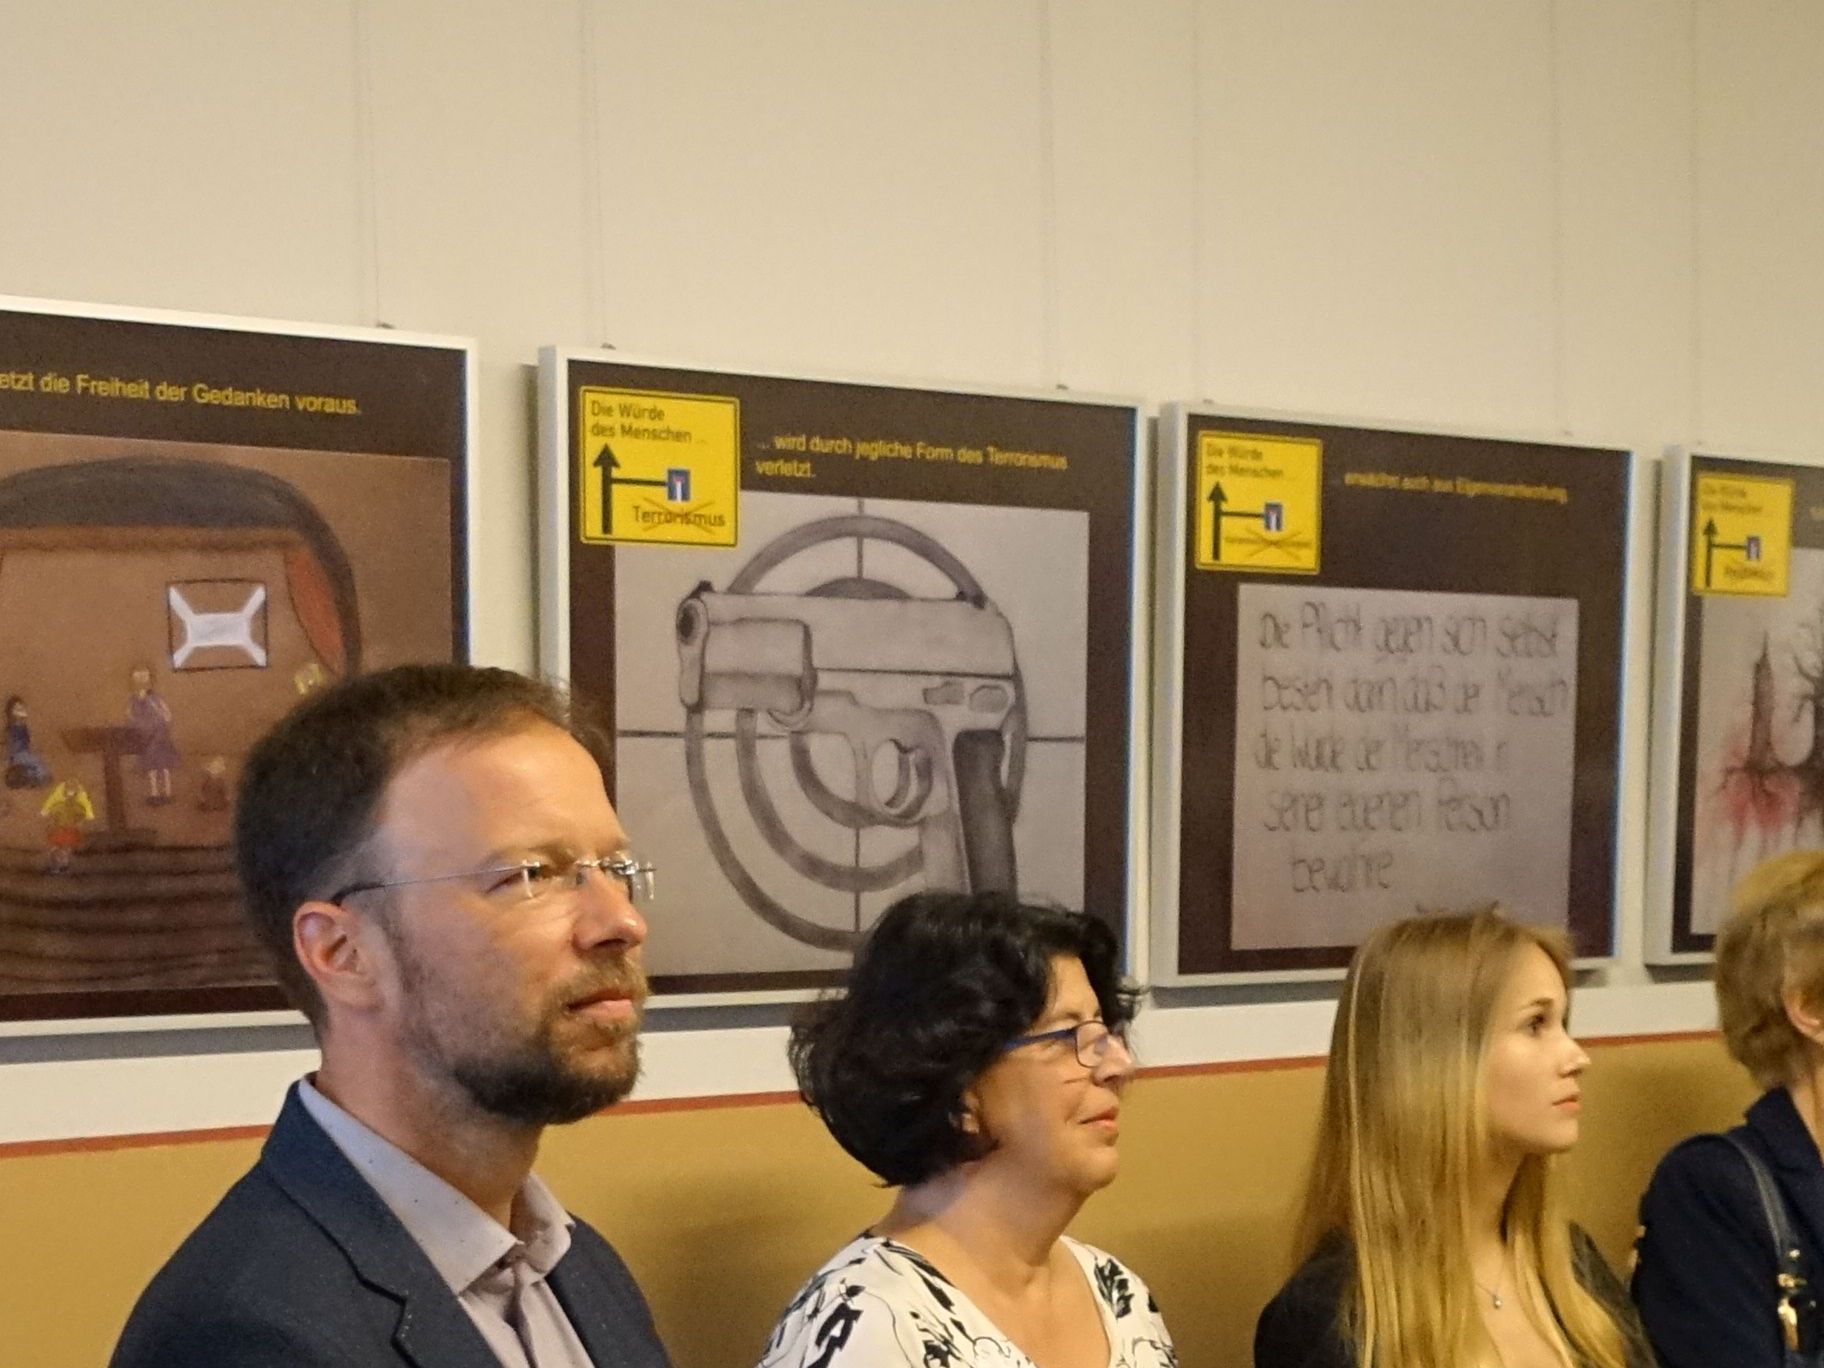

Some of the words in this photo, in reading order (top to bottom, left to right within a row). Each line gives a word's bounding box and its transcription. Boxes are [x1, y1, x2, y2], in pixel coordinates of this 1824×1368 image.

[40, 372, 71, 394] die
[76, 373, 150, 399] Freiheit
[154, 381, 188, 402] der
[192, 382, 291, 410] Gedanken
[295, 393, 362, 415] voraus.
[591, 400, 613, 417] Die
[619, 402, 665, 421] Würde
[591, 422, 616, 437] des
[620, 424, 692, 443] Menschen
[809, 435, 853, 455] durch
[916, 441, 954, 461] Form
[632, 505, 726, 527] Terrorismus
